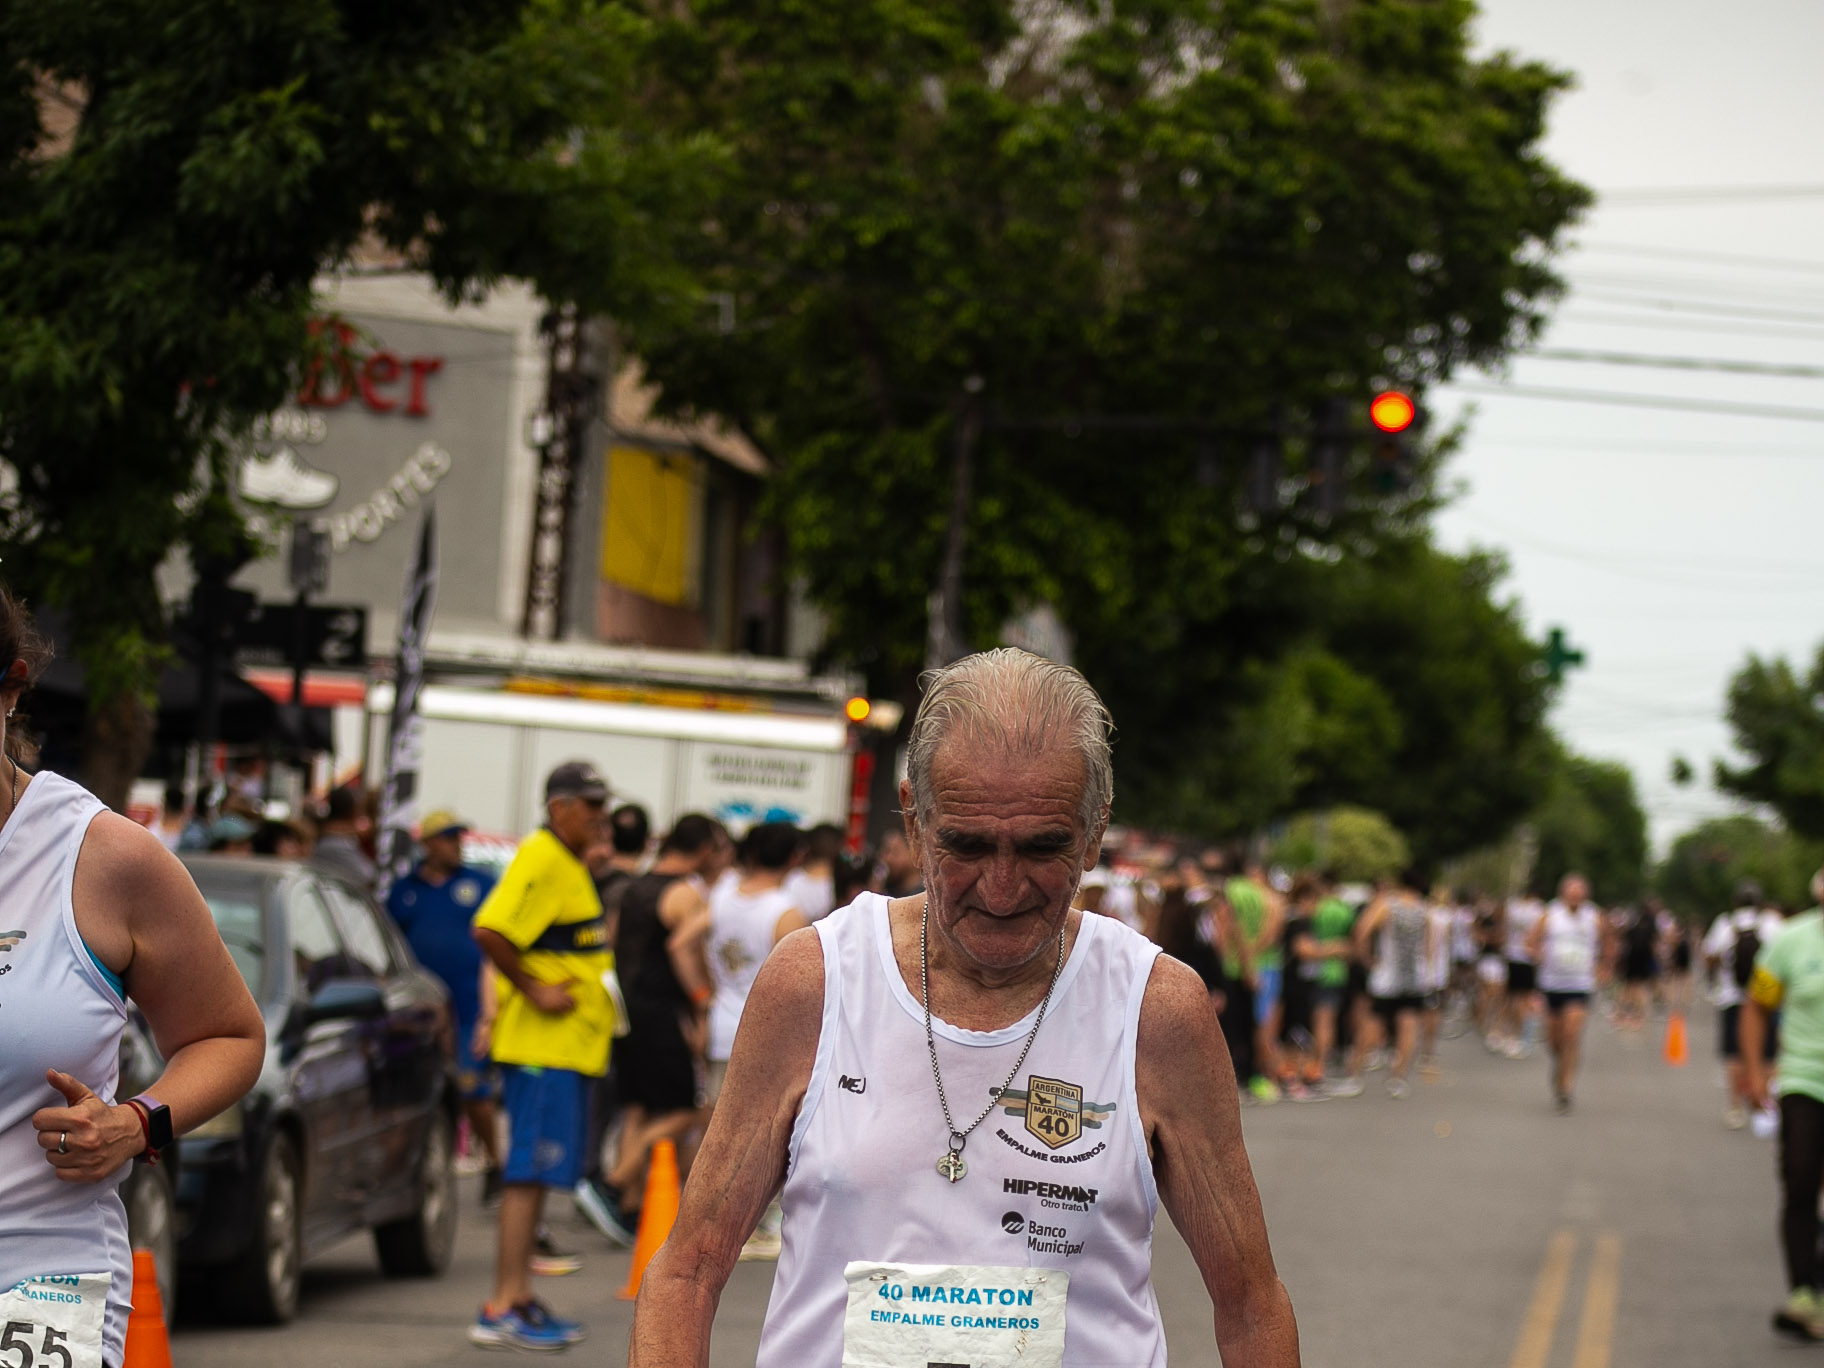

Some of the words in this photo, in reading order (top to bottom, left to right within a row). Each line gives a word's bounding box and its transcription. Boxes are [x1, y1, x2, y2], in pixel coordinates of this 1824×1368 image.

[838, 1075, 866, 1094] NEJ
[1035, 1082, 1076, 1099] ARGENTINA
[1037, 1115, 1070, 1137] 40
[995, 1128, 1049, 1162] EMPALME
[1049, 1141, 1107, 1164] GRANEROS
[1040, 1199, 1061, 1209] Otro
[1028, 1220, 1067, 1238] Banco
[1027, 1235, 1085, 1257] Municipal
[878, 1282, 903, 1301] 40
[911, 1285, 1034, 1307] MARATON
[870, 1309, 946, 1327] EMPALME
[951, 1314, 1040, 1330] GRANEROS
